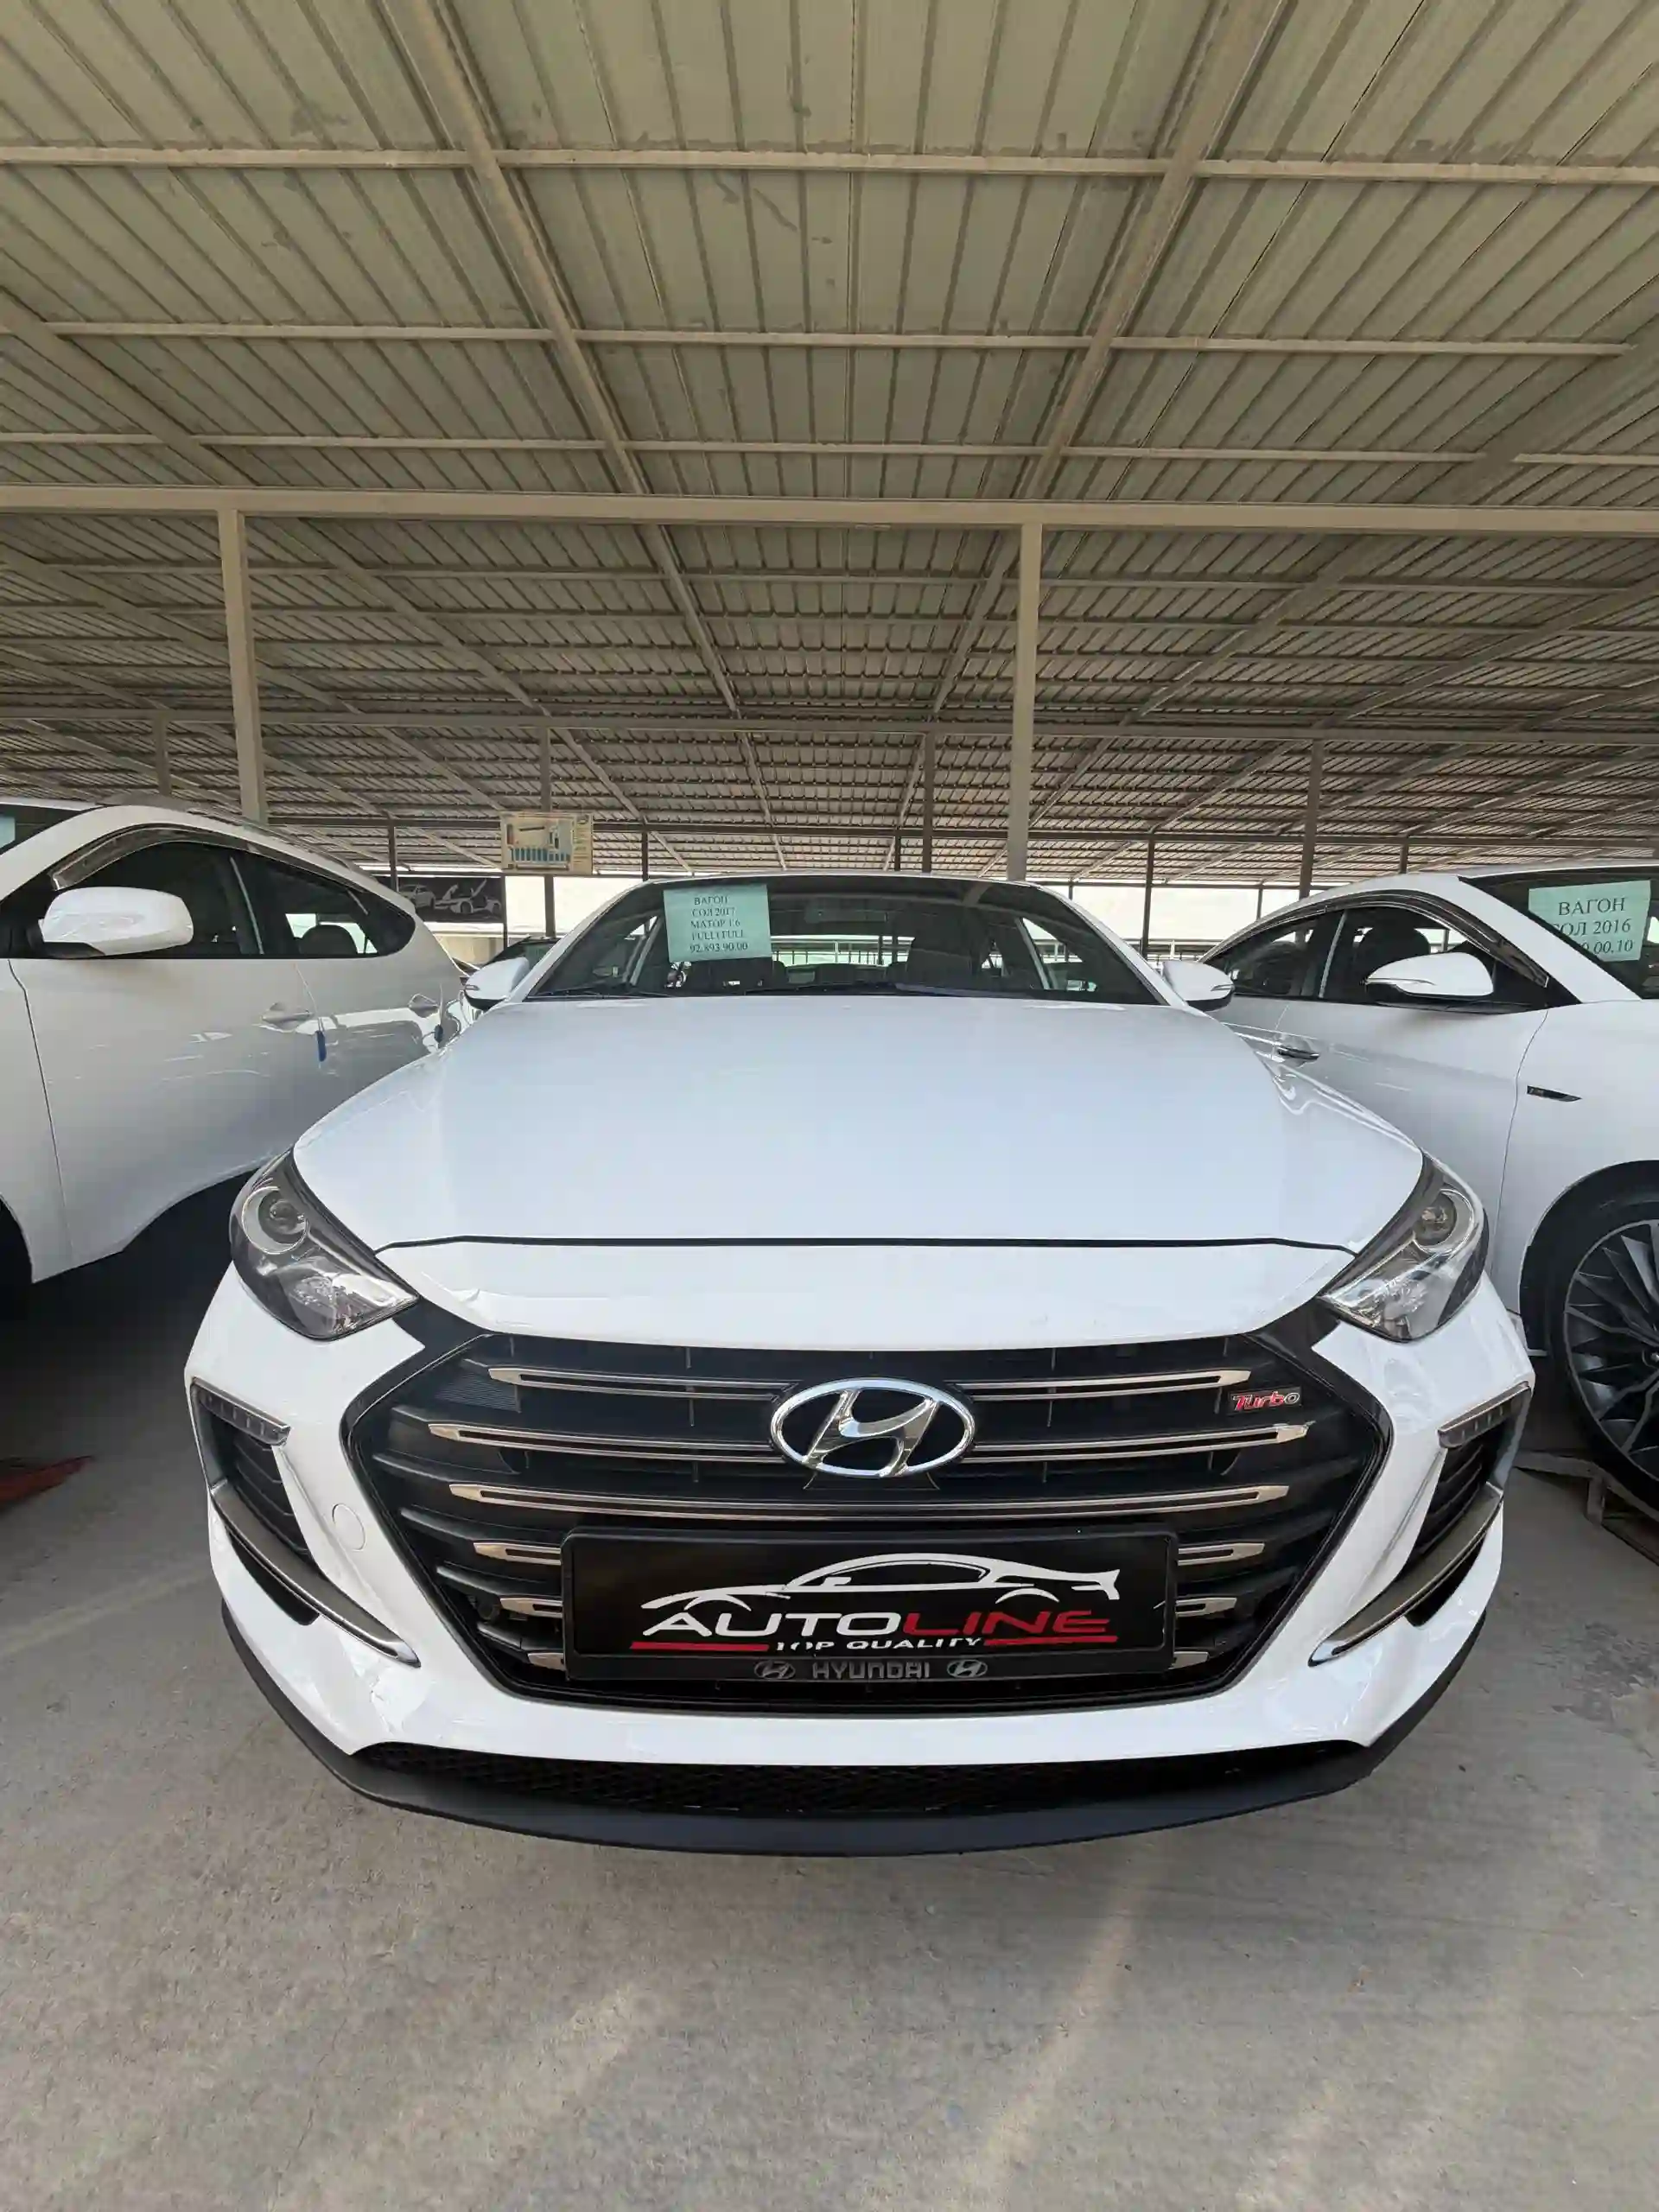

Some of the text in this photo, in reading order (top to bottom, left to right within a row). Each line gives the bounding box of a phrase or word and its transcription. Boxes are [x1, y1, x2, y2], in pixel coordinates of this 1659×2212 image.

[1558, 897, 1628, 916] ВАГОН
[1554, 918, 1632, 936] ОЛ 2016
[642, 1611, 1110, 1637] AUTOLINE
[846, 1637, 982, 1649] QUALITY
[811, 1662, 931, 1679] HYUNDAI
